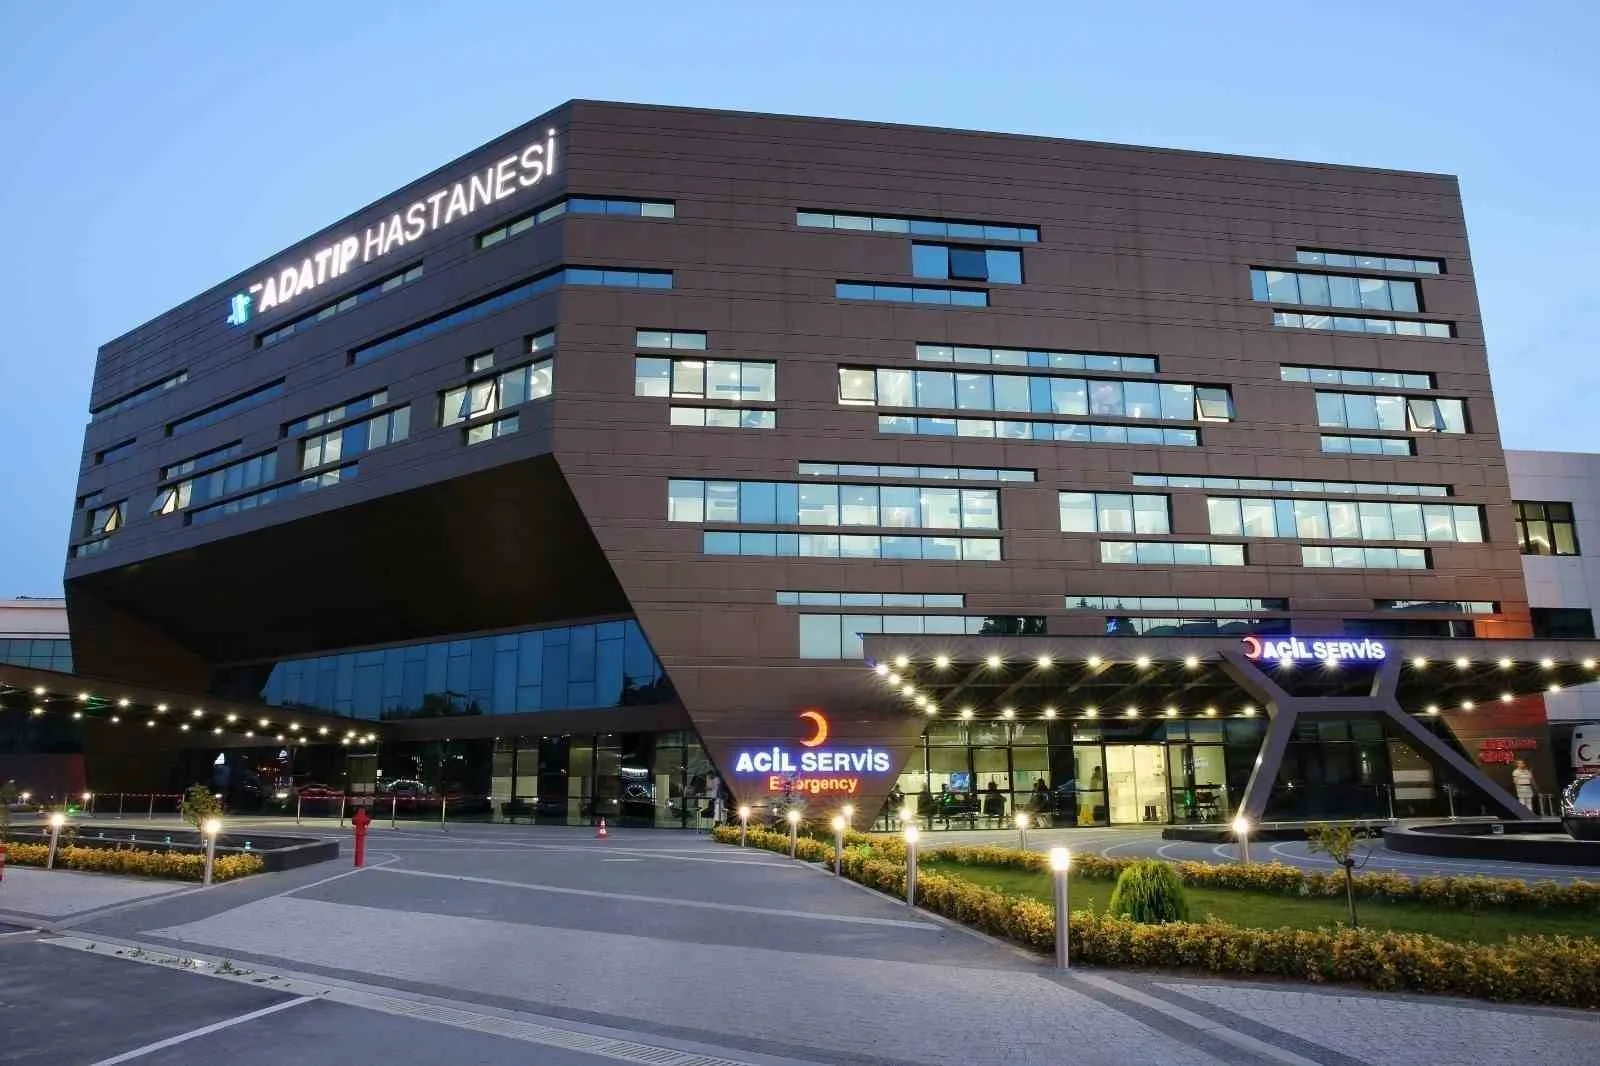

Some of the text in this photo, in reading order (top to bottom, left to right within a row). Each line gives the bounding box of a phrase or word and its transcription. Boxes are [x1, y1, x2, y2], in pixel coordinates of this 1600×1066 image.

[258, 128, 556, 313] ADATIP HASTANESİ
[1263, 636, 1386, 660] ACİL SERVİS
[735, 746, 890, 772] ACİL SERVİS
